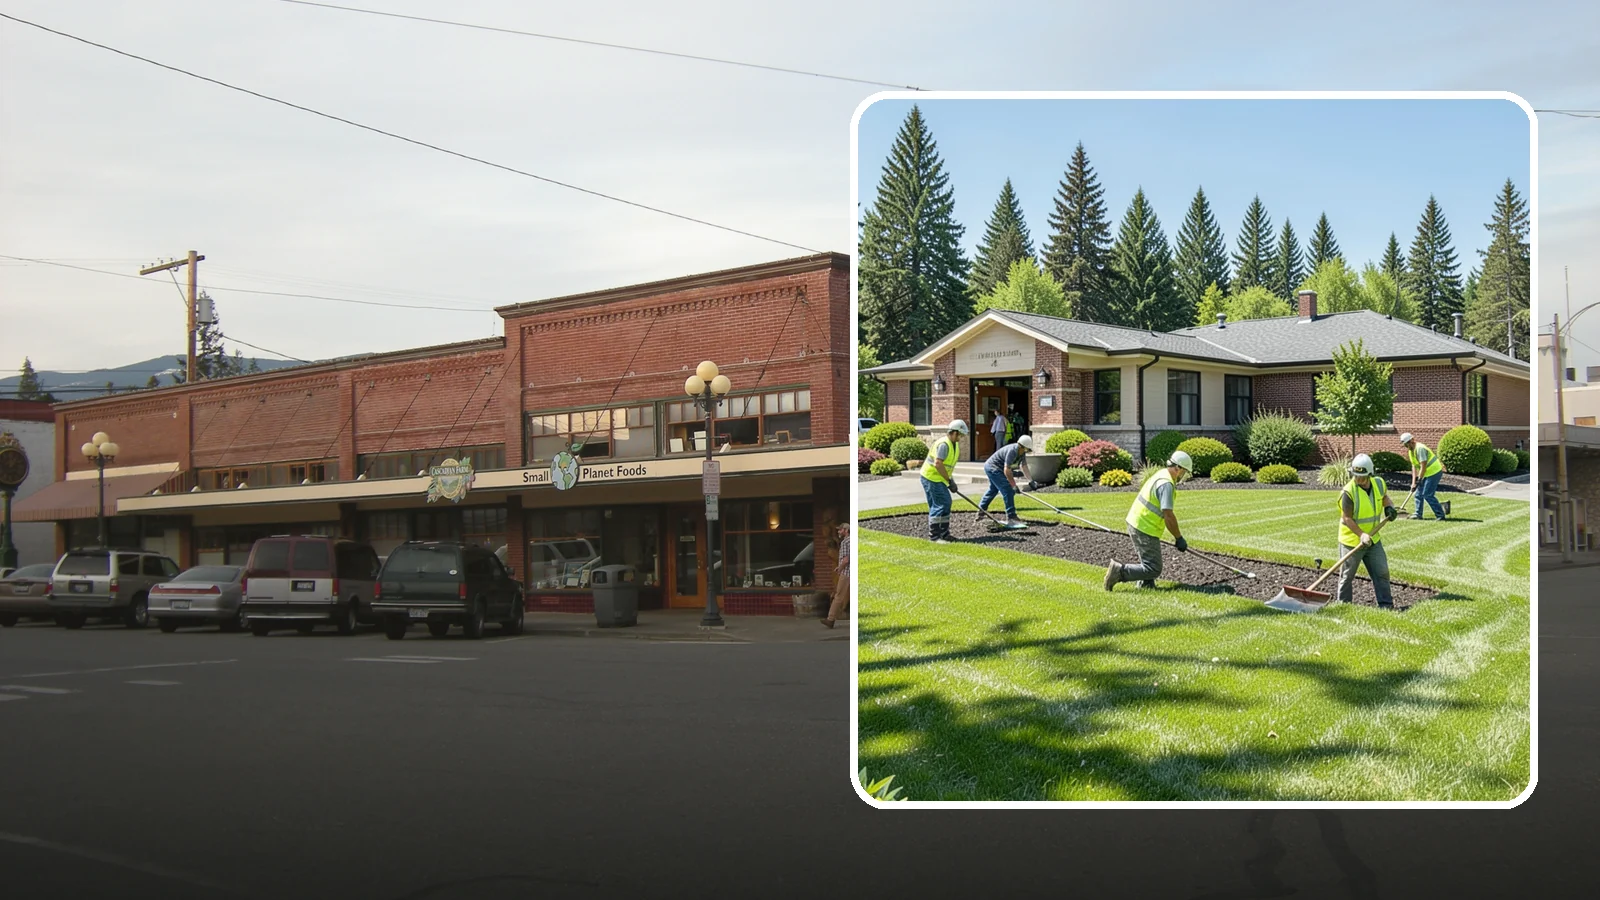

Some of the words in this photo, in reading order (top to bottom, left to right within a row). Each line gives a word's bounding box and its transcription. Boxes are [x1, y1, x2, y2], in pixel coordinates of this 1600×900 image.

[523, 470, 549, 483] Small
[582, 467, 614, 479] Planet
[616, 464, 647, 477] Foods
